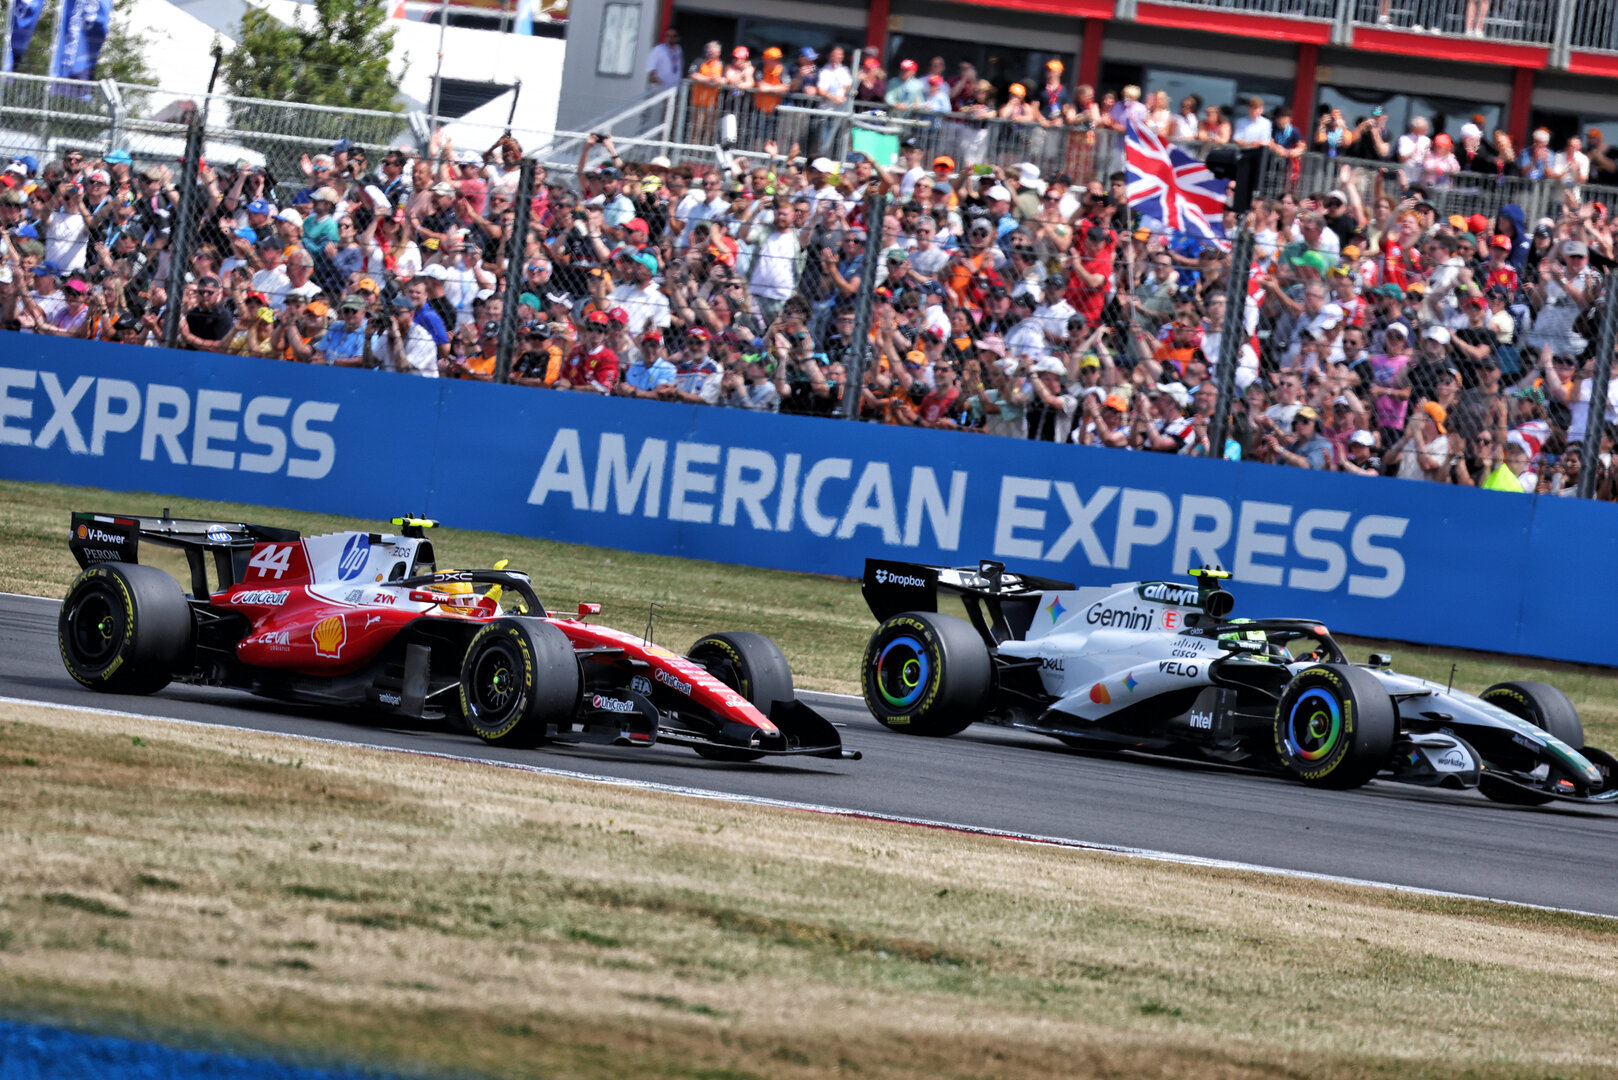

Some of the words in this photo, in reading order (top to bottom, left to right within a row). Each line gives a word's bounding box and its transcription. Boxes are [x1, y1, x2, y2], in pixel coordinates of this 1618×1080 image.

[0, 367, 340, 479] EXPRESS
[527, 428, 968, 551] AMERICAN
[993, 475, 1410, 599] EXPRESS
[87, 528, 126, 545] V-Power
[83, 547, 121, 561] PERONI
[249, 544, 293, 579] 44
[340, 533, 369, 580] hp
[888, 572, 926, 588] Dropbox
[241, 589, 291, 605] UniCredit
[373, 592, 398, 605] ZYN
[1143, 583, 1199, 606] allwyn
[888, 617, 924, 631] ZERO
[1086, 602, 1154, 631] Gemini
[1166, 613, 1177, 628] E
[517, 638, 532, 687] ZERO
[1042, 657, 1064, 671] DELL
[1159, 661, 1198, 678] VELO
[631, 677, 650, 693] FIA
[662, 671, 692, 696] UniCredit
[601, 696, 634, 712] UniCredit
[1189, 709, 1213, 730] intel
[1437, 757, 1466, 769] workday
